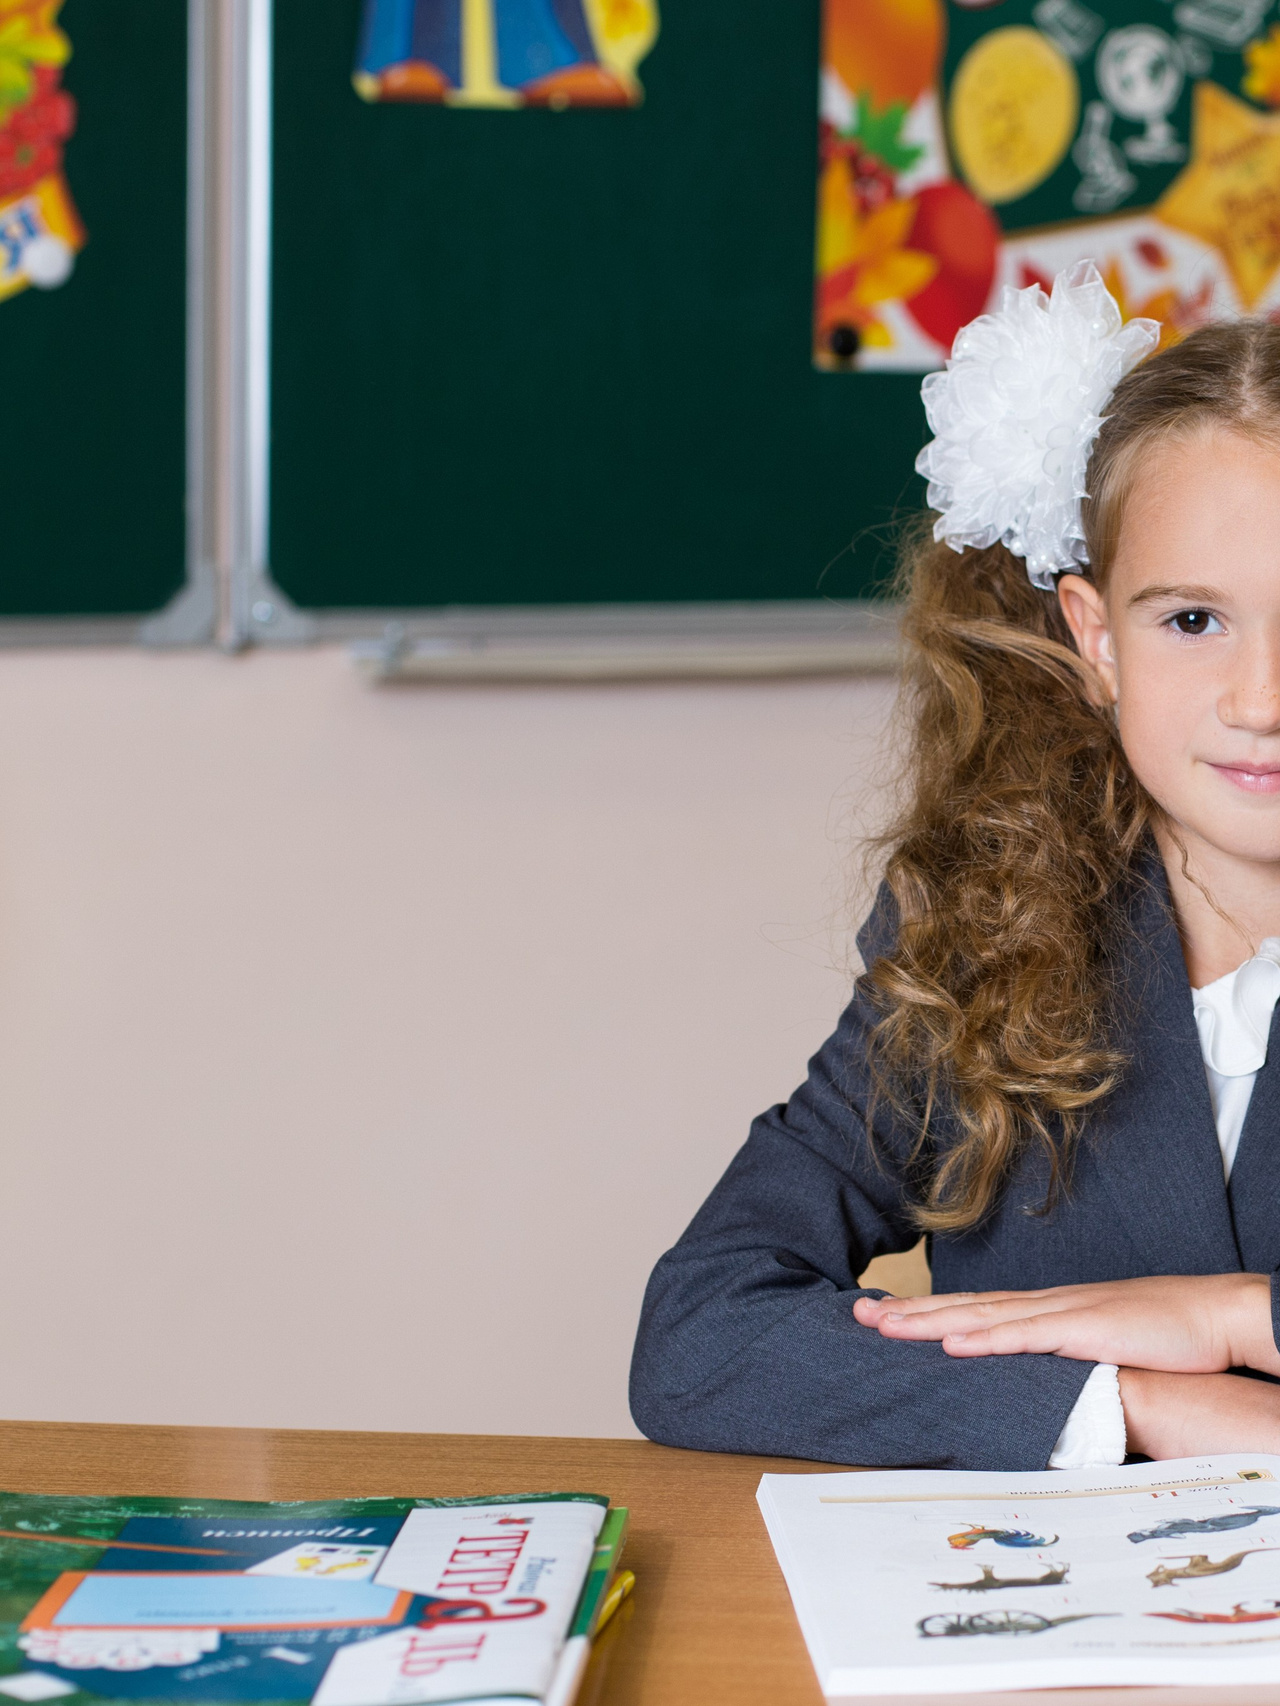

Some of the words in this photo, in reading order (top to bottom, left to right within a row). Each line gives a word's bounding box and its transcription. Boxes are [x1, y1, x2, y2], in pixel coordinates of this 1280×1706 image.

[1150, 1476, 1225, 1487] Слушаем
[1084, 1484, 1138, 1493] чтение
[1187, 1485, 1230, 1494] Урок
[1150, 1490, 1180, 1498] 14
[202, 1527, 379, 1540] Прописи
